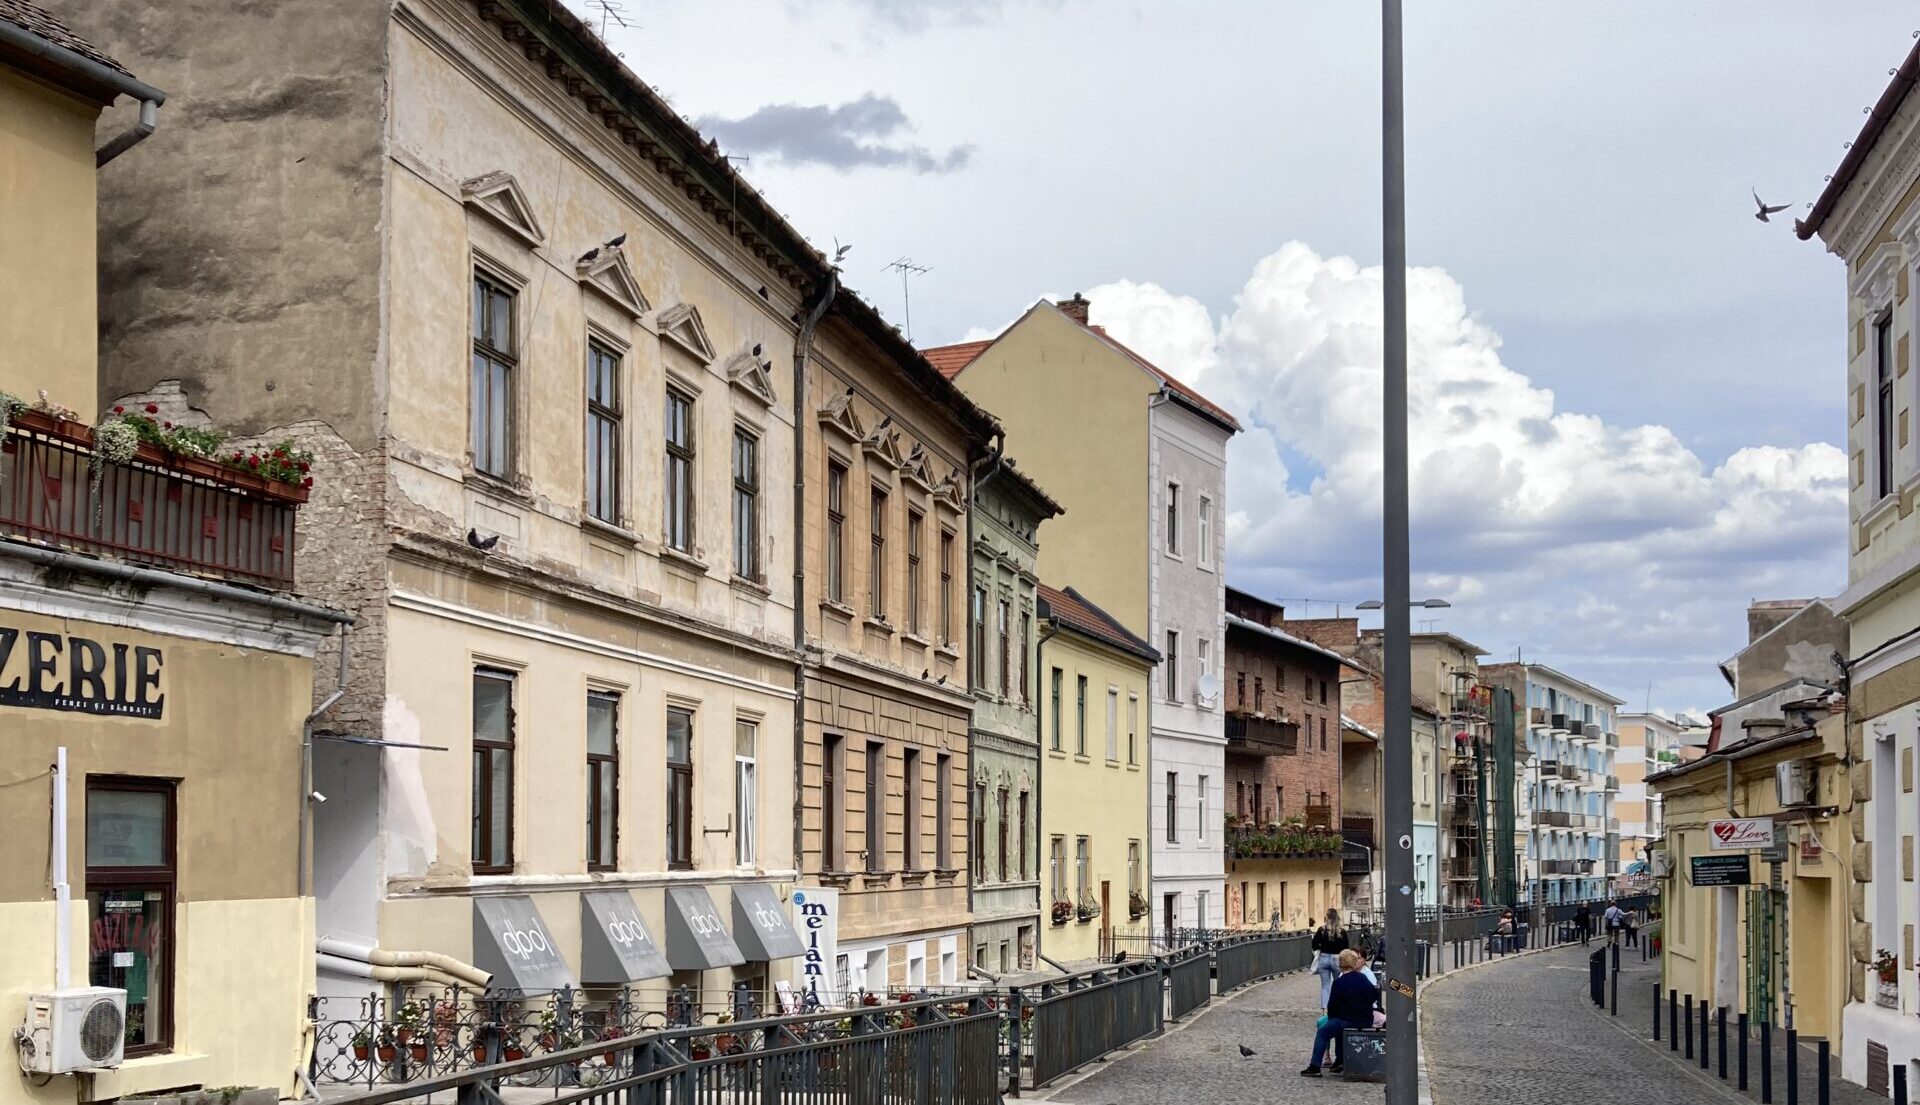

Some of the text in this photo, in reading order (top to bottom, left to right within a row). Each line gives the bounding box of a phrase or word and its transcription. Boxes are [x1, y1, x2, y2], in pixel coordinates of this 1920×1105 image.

[0, 627, 164, 706] ZERIE
[54, 698, 88, 709] FEMEI
[1719, 822, 1769, 841] 4 Love
